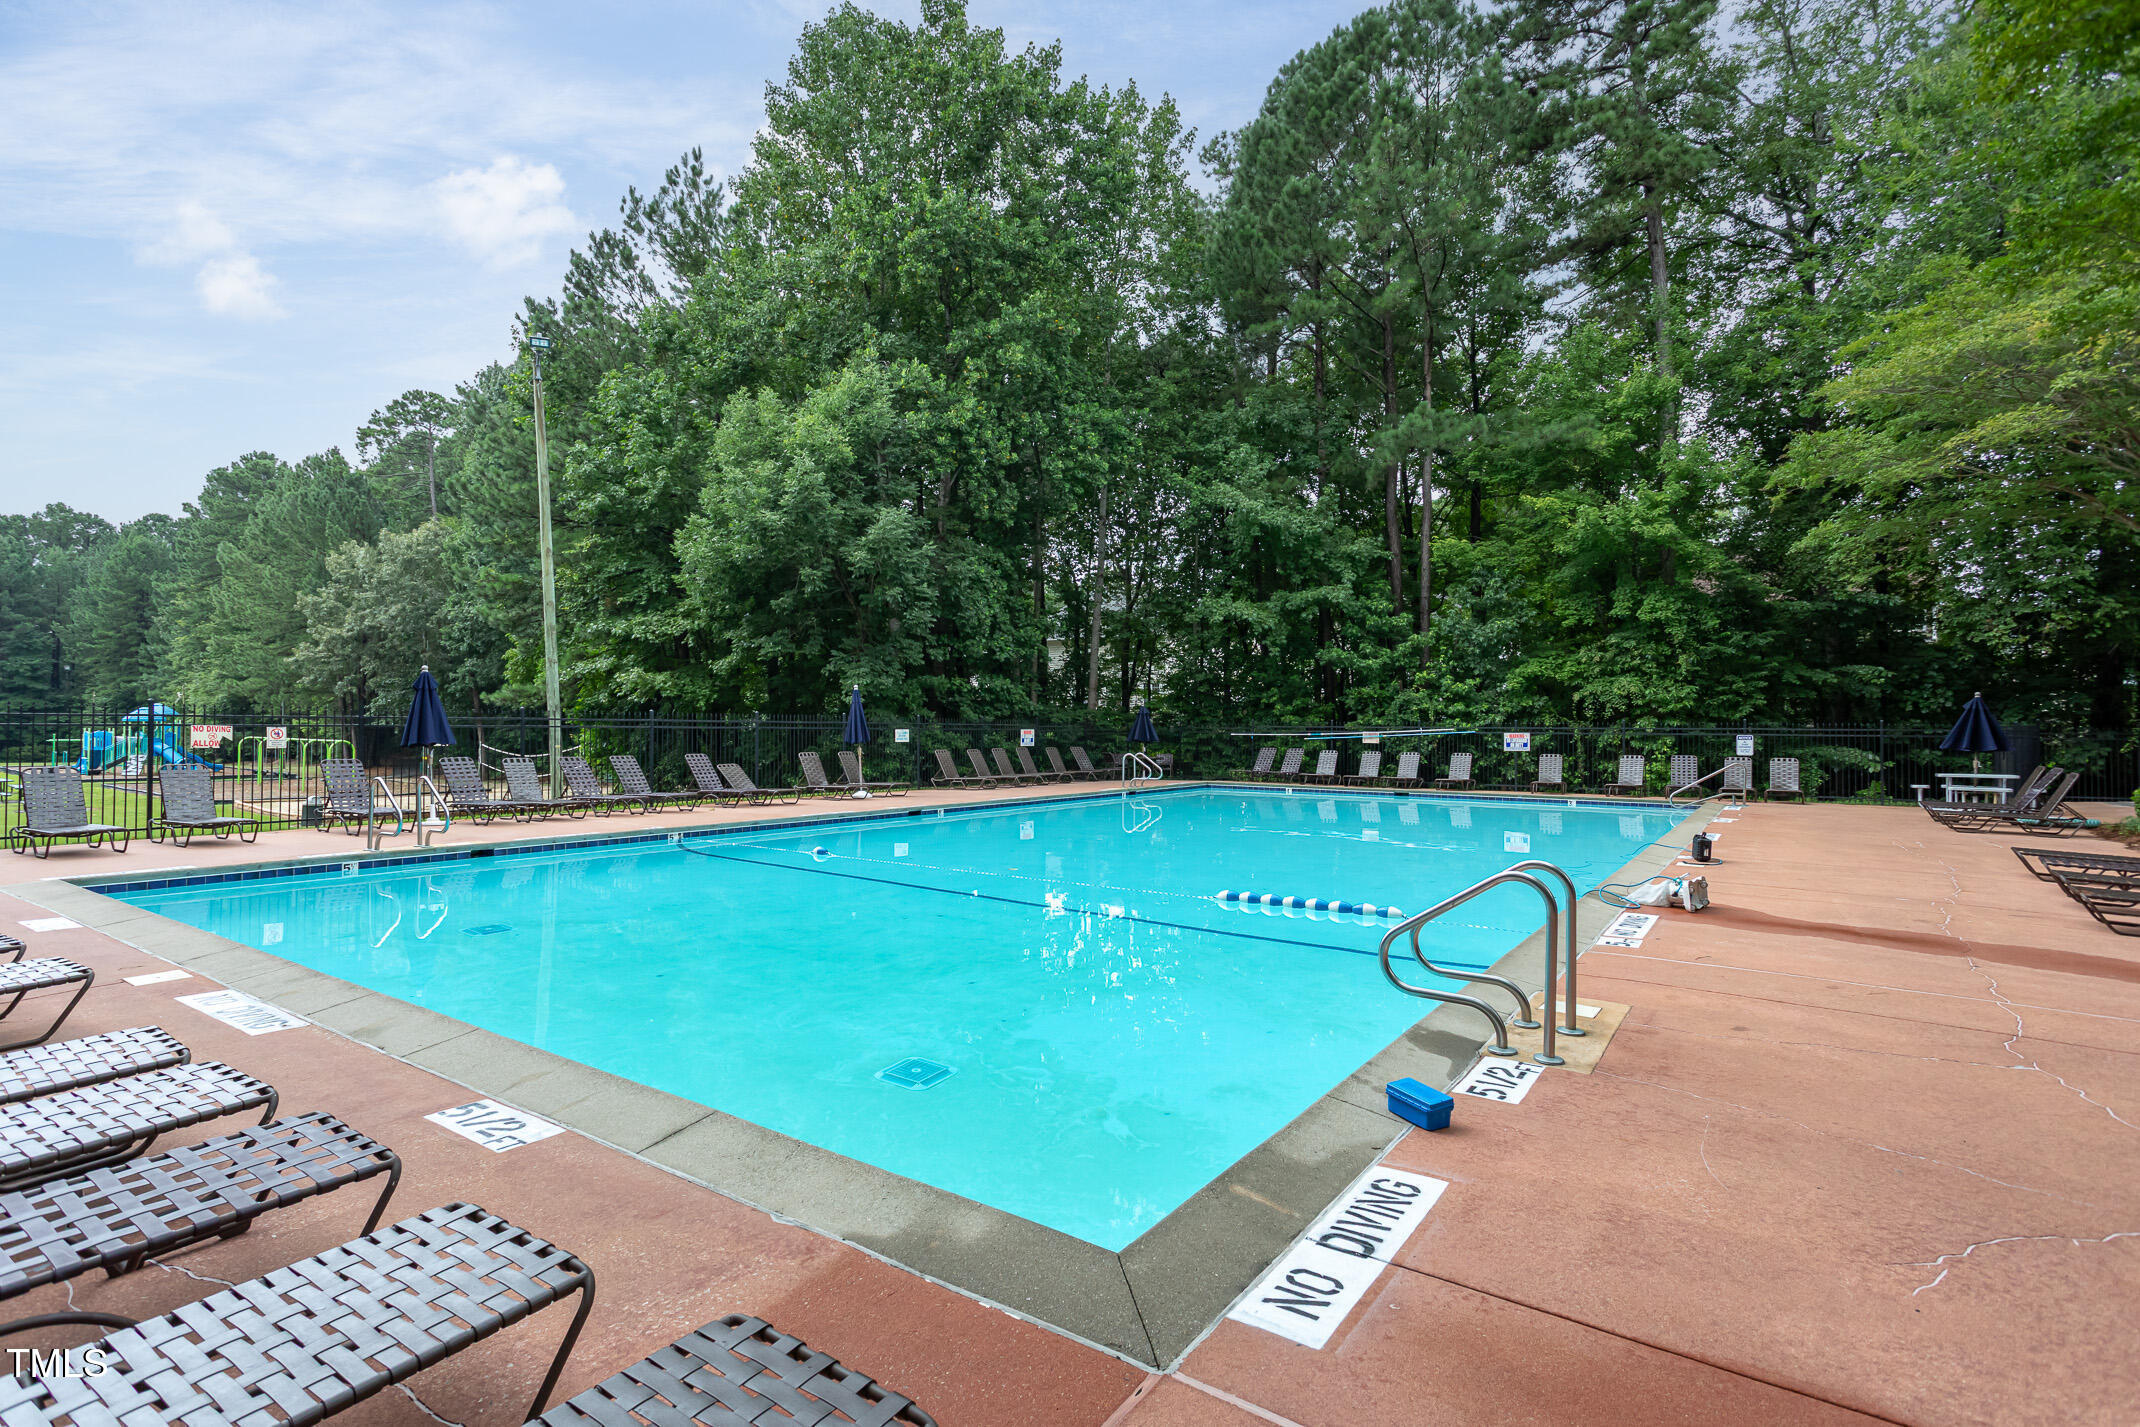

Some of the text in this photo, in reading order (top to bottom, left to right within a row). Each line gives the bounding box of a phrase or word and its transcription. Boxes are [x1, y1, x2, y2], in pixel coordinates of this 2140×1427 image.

[193, 725, 232, 733] NO DIVING
[1261, 1178, 1422, 1321] NO DIVING
